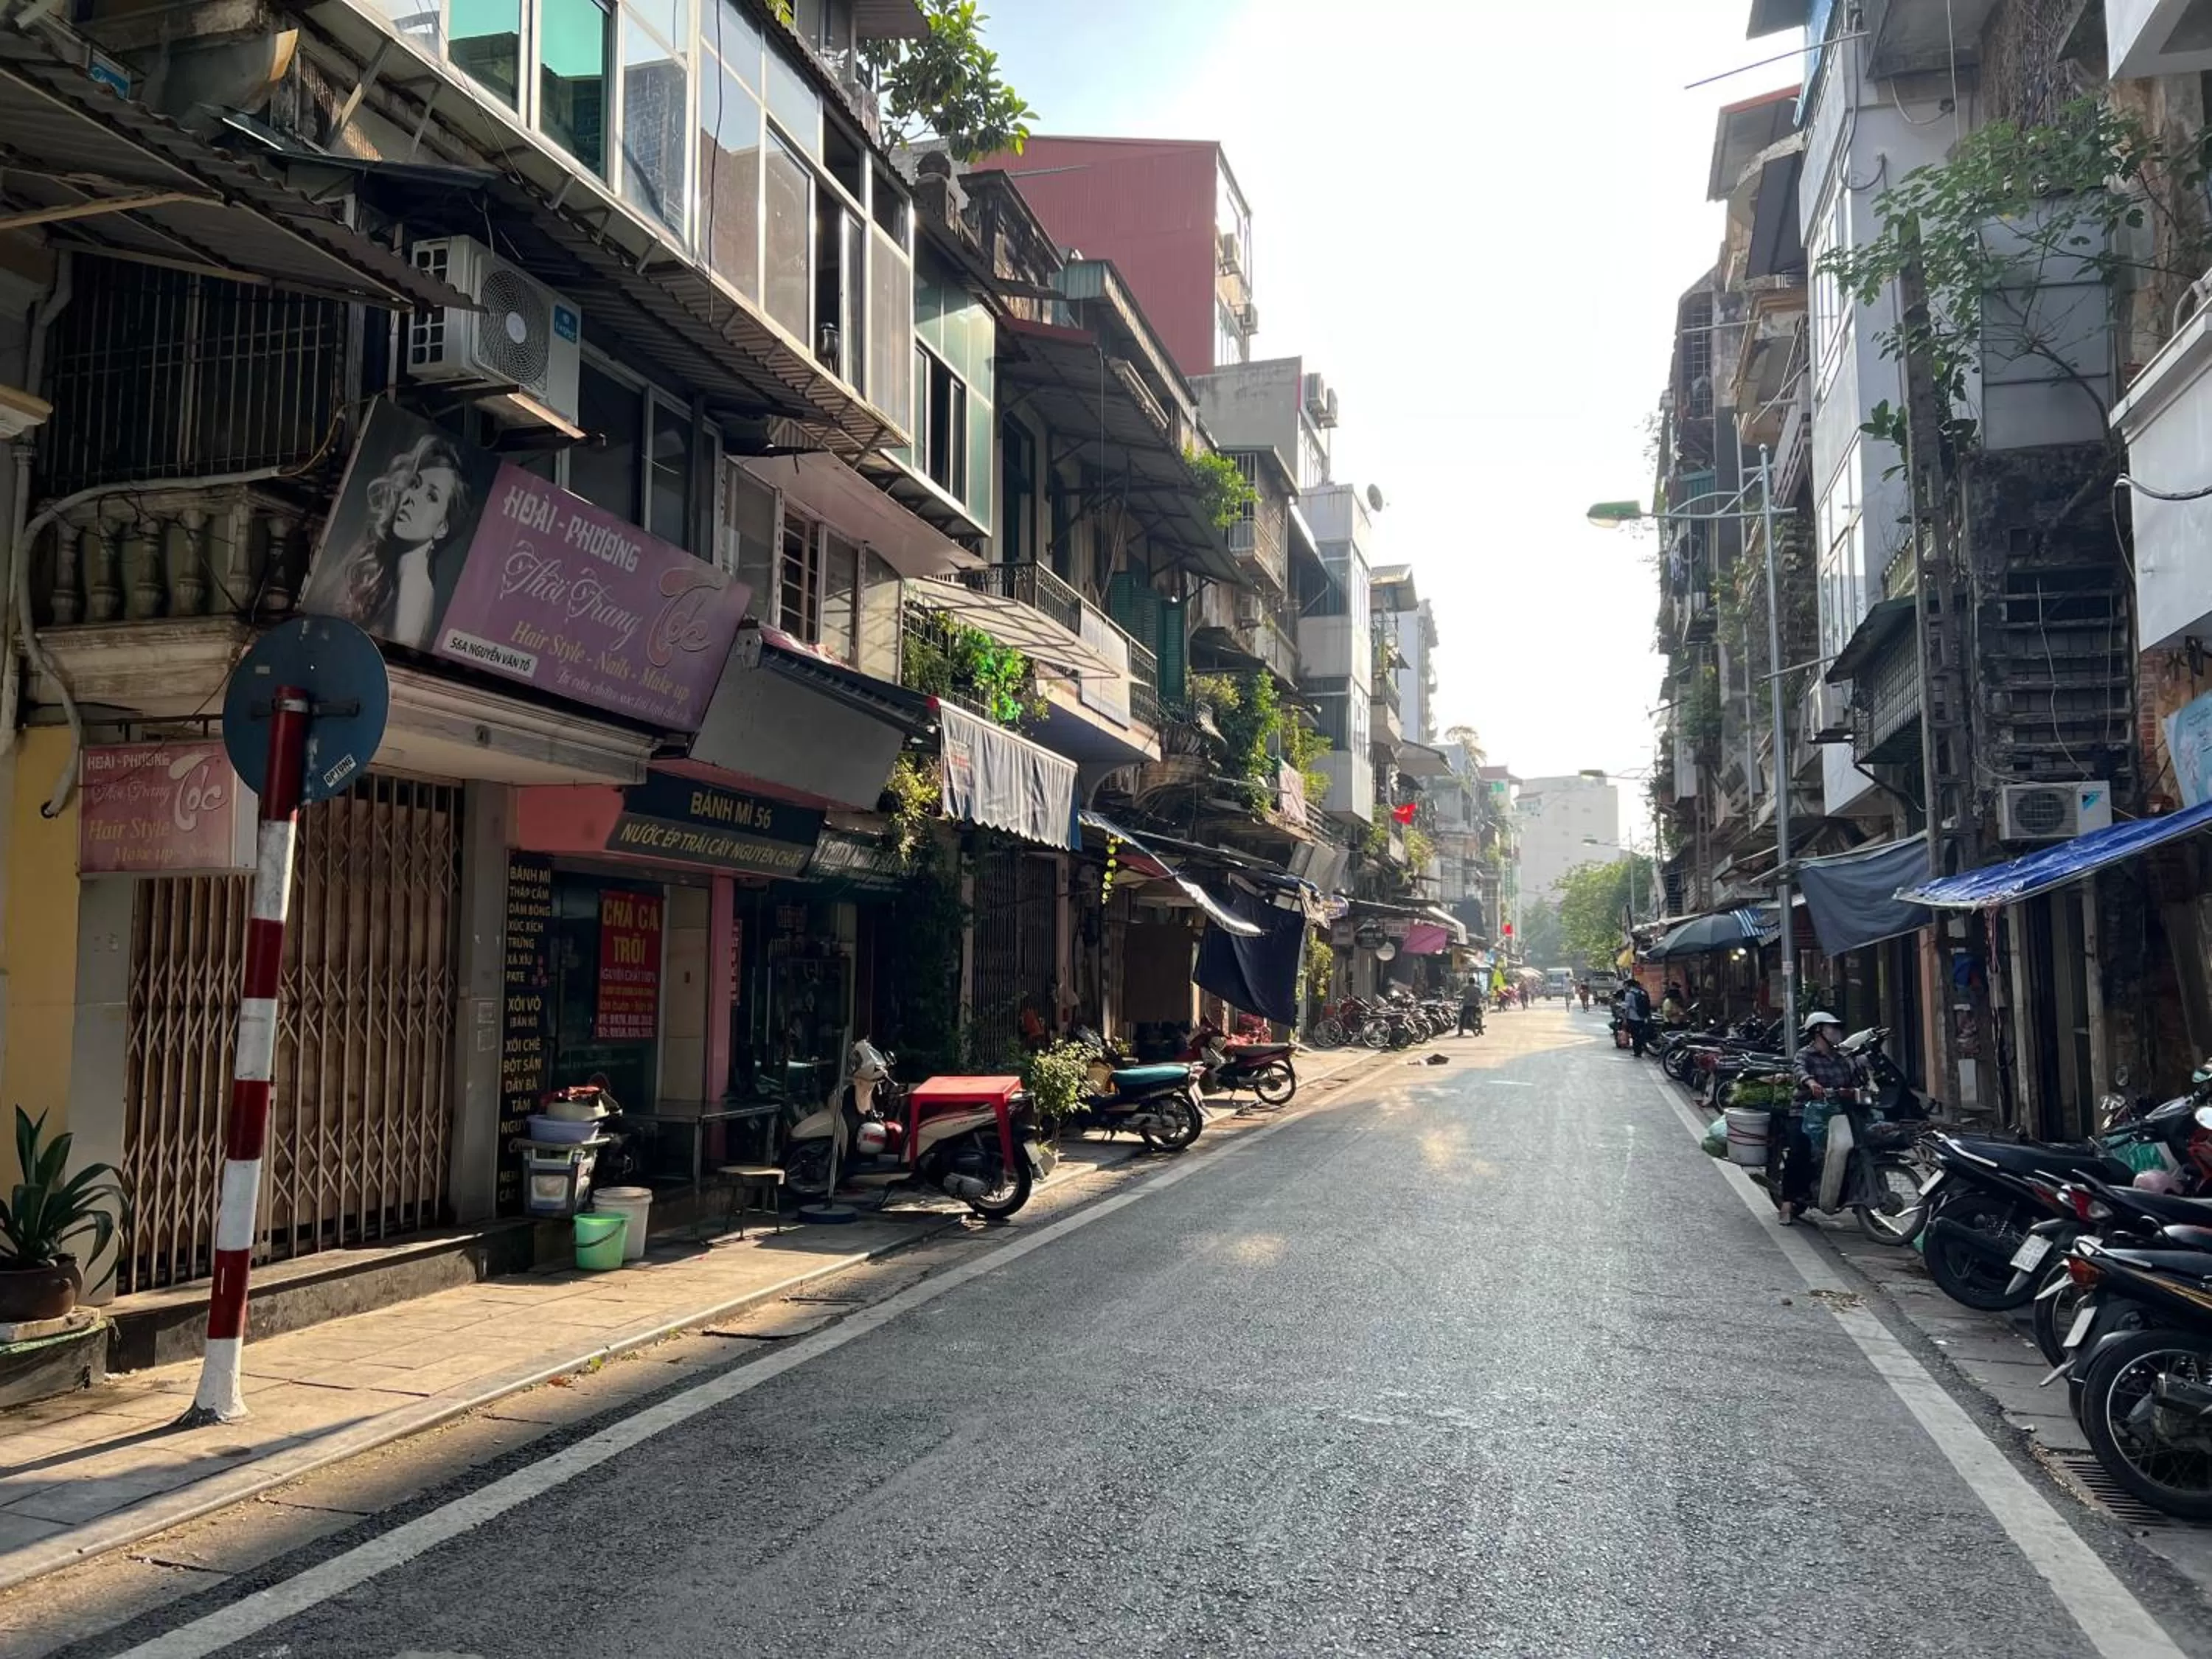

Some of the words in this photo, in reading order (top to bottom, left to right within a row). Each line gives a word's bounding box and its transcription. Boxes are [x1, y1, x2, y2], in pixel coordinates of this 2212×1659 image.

[502, 486, 558, 535] HOÀI
[564, 515, 642, 573] PHƯƠNG
[510, 621, 549, 651] Hair
[552, 633, 587, 664] Style
[689, 790, 732, 821] BÁNH
[754, 806, 773, 830] 56
[88, 818, 125, 841] Hair
[130, 815, 171, 846] Style
[620, 822, 662, 846] NƯỚC
[662, 827, 681, 848] ÉP
[680, 832, 709, 854] TRÁI
[730, 841, 776, 865] NGUYÊN
[509, 863, 538, 883] BÁNH
[602, 893, 634, 930] CHẢ
[638, 900, 660, 932] CÁ
[613, 932, 647, 964] TRÔI
[504, 1057, 523, 1077] BỘT
